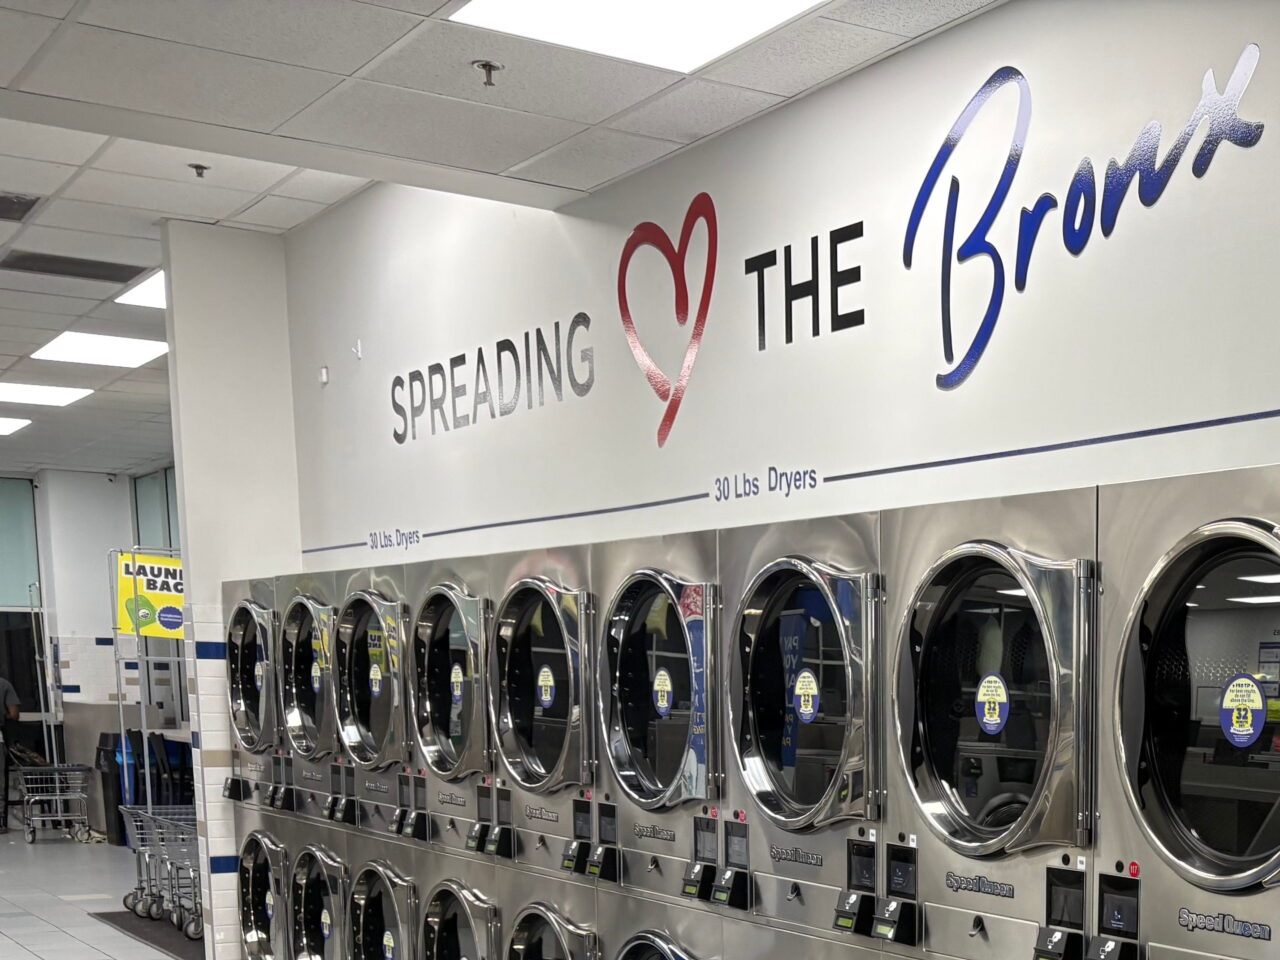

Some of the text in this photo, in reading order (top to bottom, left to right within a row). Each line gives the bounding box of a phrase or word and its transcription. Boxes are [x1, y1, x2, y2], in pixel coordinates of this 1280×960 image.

[392, 312, 594, 444] SPREADING
[744, 220, 864, 351] THE
[904, 43, 1264, 391] Bronx
[715, 466, 817, 502] 30 Lbs Dryers
[370, 529, 420, 550] 30 Lbs. Dryers
[1237, 708, 1248, 719] 32
[1179, 908, 1271, 941] Speed Queen
